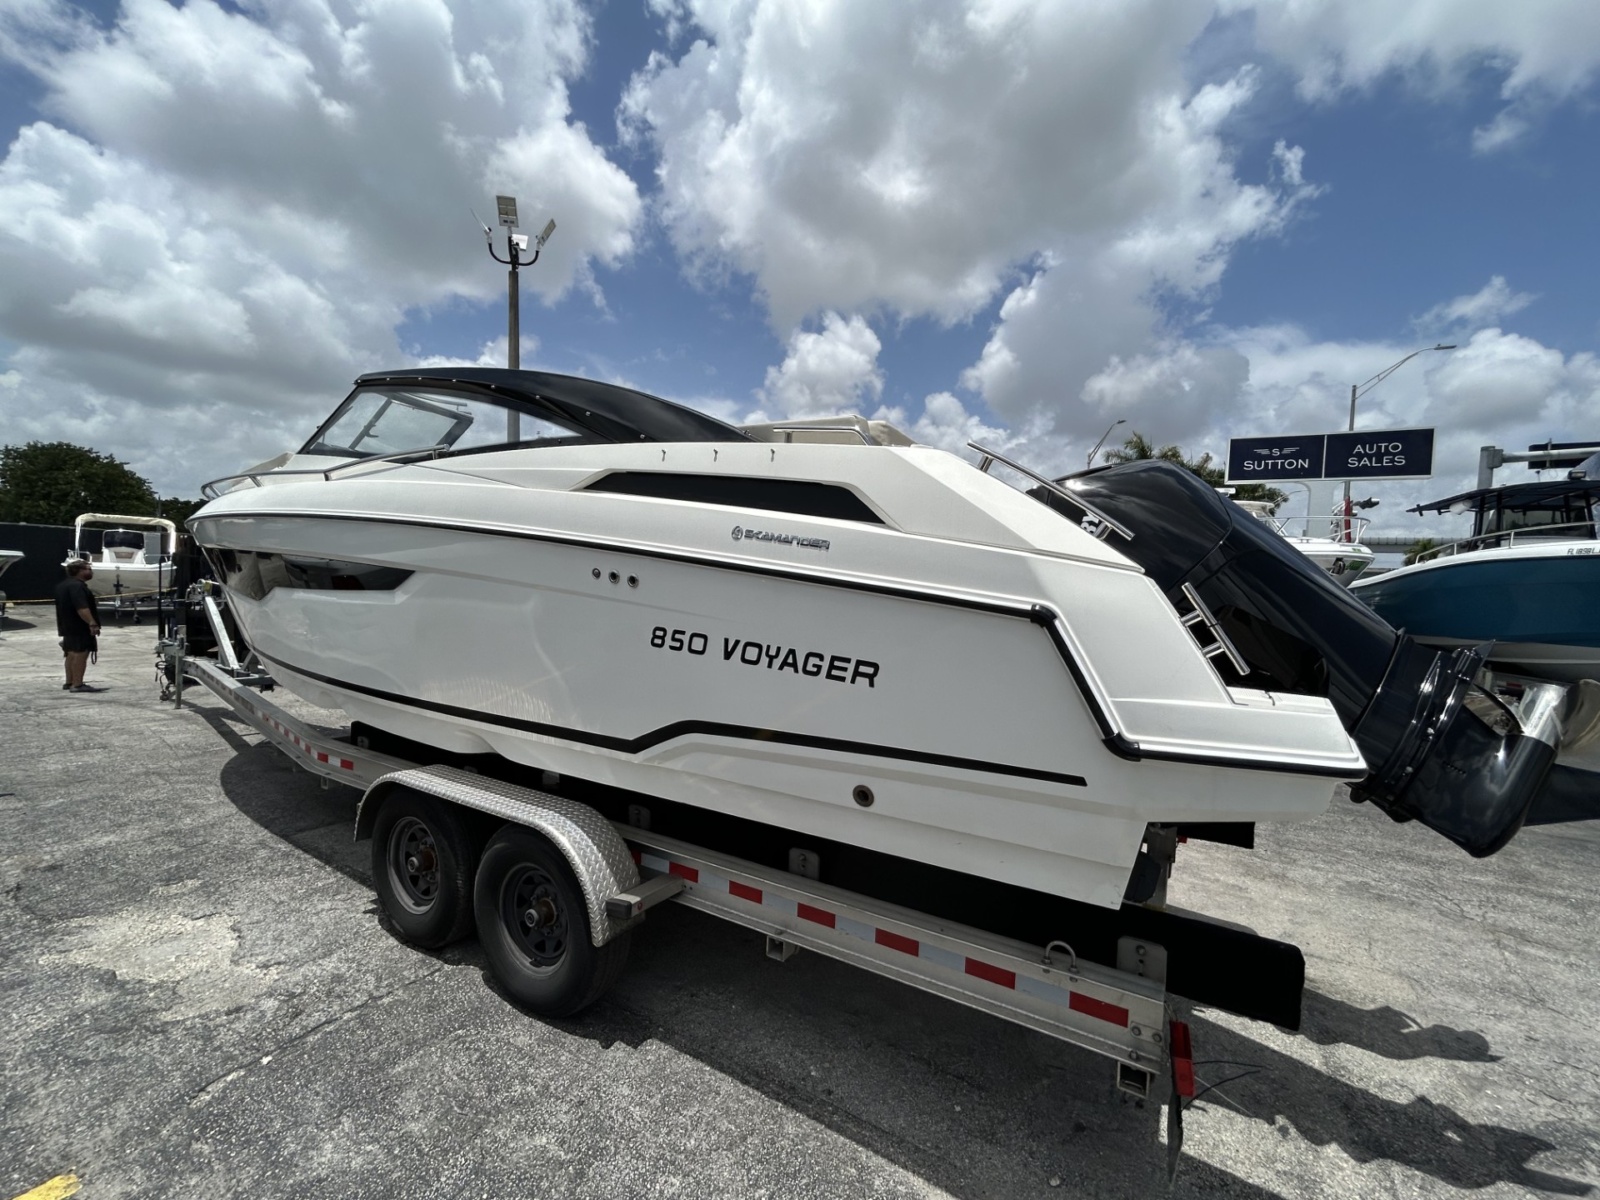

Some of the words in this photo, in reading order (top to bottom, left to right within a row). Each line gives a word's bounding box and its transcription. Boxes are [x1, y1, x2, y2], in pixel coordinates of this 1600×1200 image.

[1352, 442, 1402, 455] AUTO
[1243, 458, 1309, 471] SUTTON
[1347, 455, 1406, 468] SALES
[743, 528, 831, 550] SKAMANDER
[650, 626, 708, 655] 850
[723, 637, 880, 688] VOYAGER
